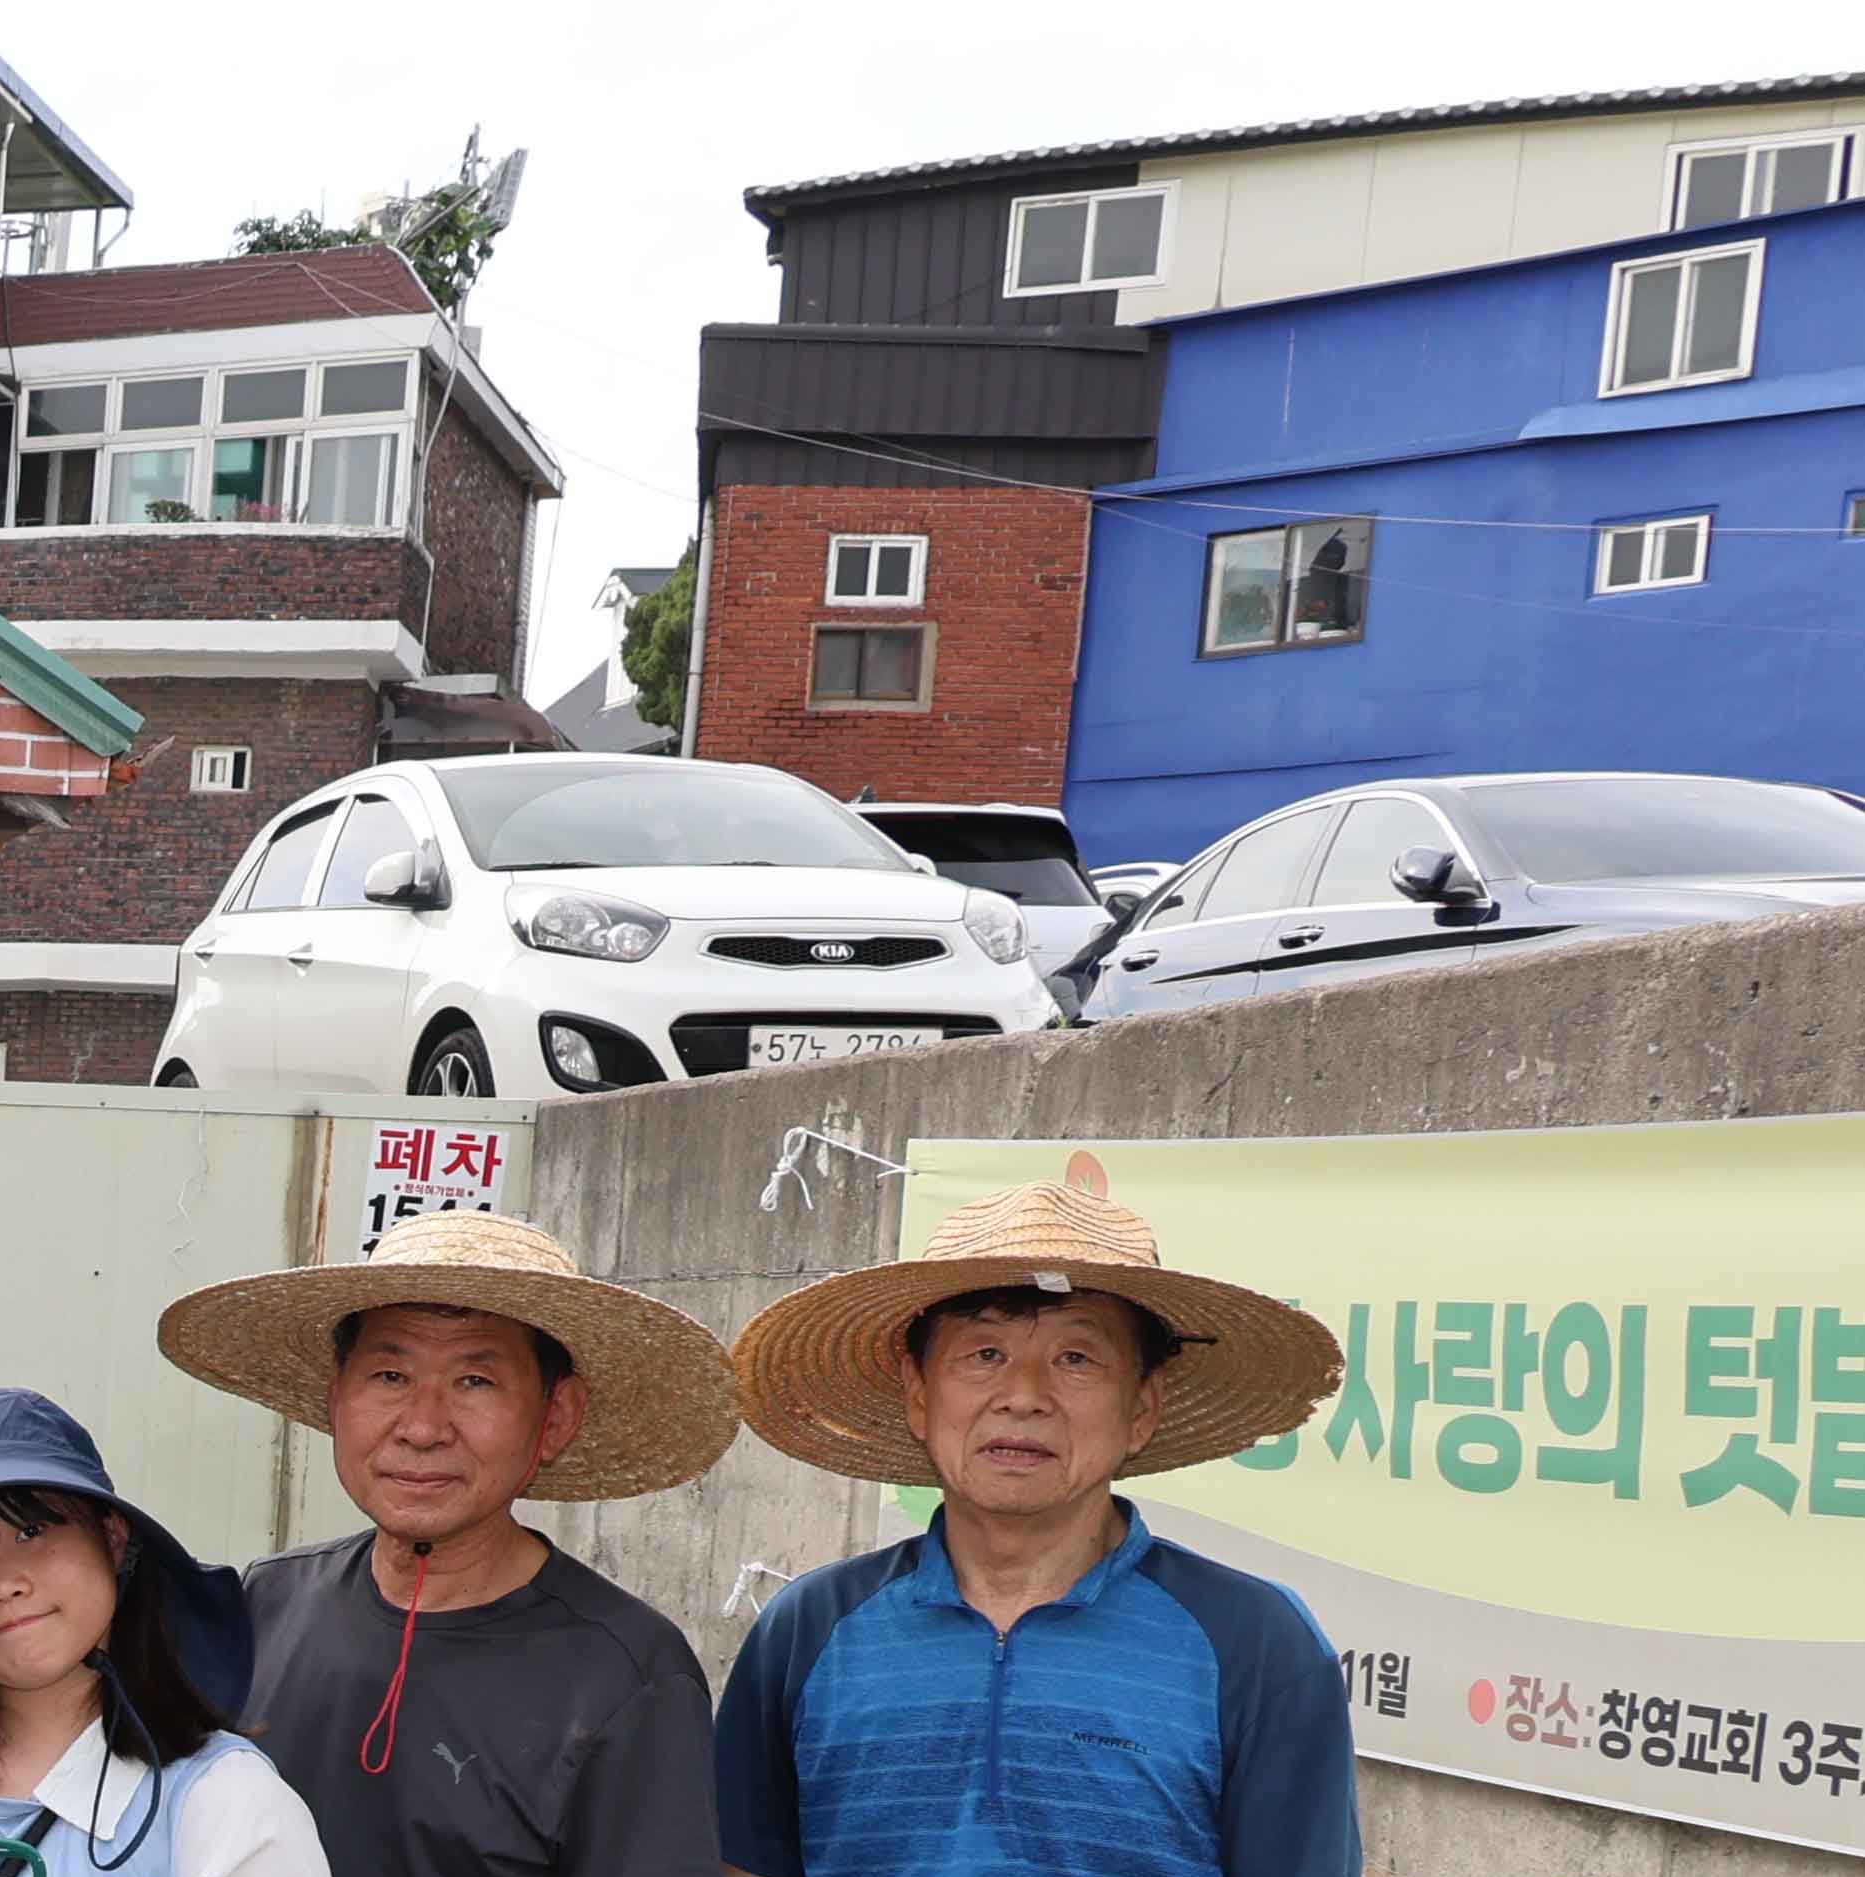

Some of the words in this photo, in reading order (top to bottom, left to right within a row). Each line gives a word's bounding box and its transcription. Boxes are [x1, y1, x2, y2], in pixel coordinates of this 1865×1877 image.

[818, 944, 849, 958] KIA
[375, 1128, 502, 1187] 폐차
[368, 1193, 492, 1233] 15
[1323, 1301, 1648, 1501] 사랑의
[1779, 1721, 1865, 1797] 3주
